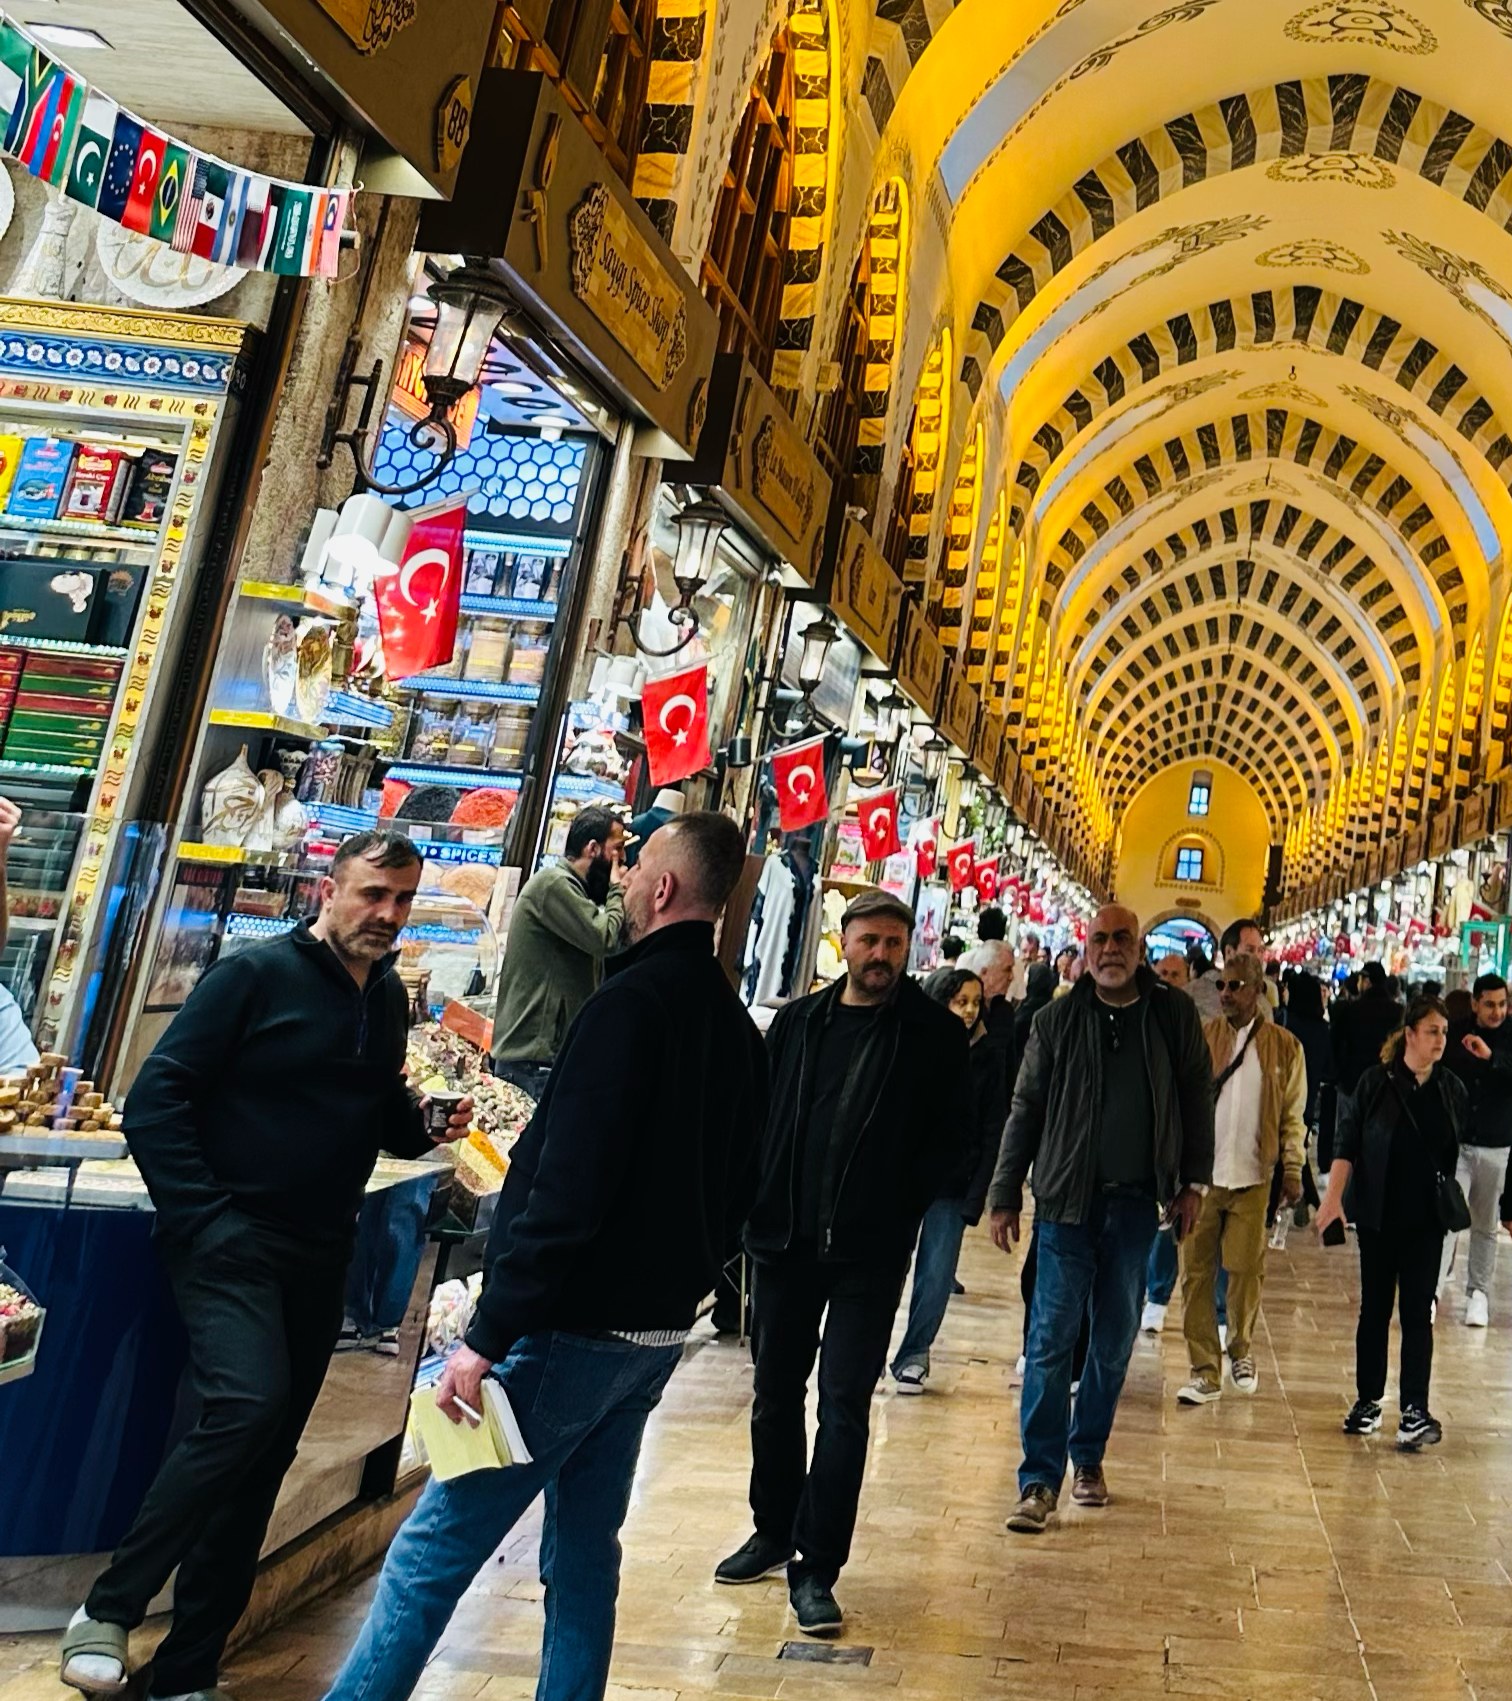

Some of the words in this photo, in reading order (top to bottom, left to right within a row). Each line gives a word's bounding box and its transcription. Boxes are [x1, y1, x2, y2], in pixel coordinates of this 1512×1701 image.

[447, 98, 469, 149] 88
[625, 267, 651, 319] Spice
[648, 296, 670, 352] Shop
